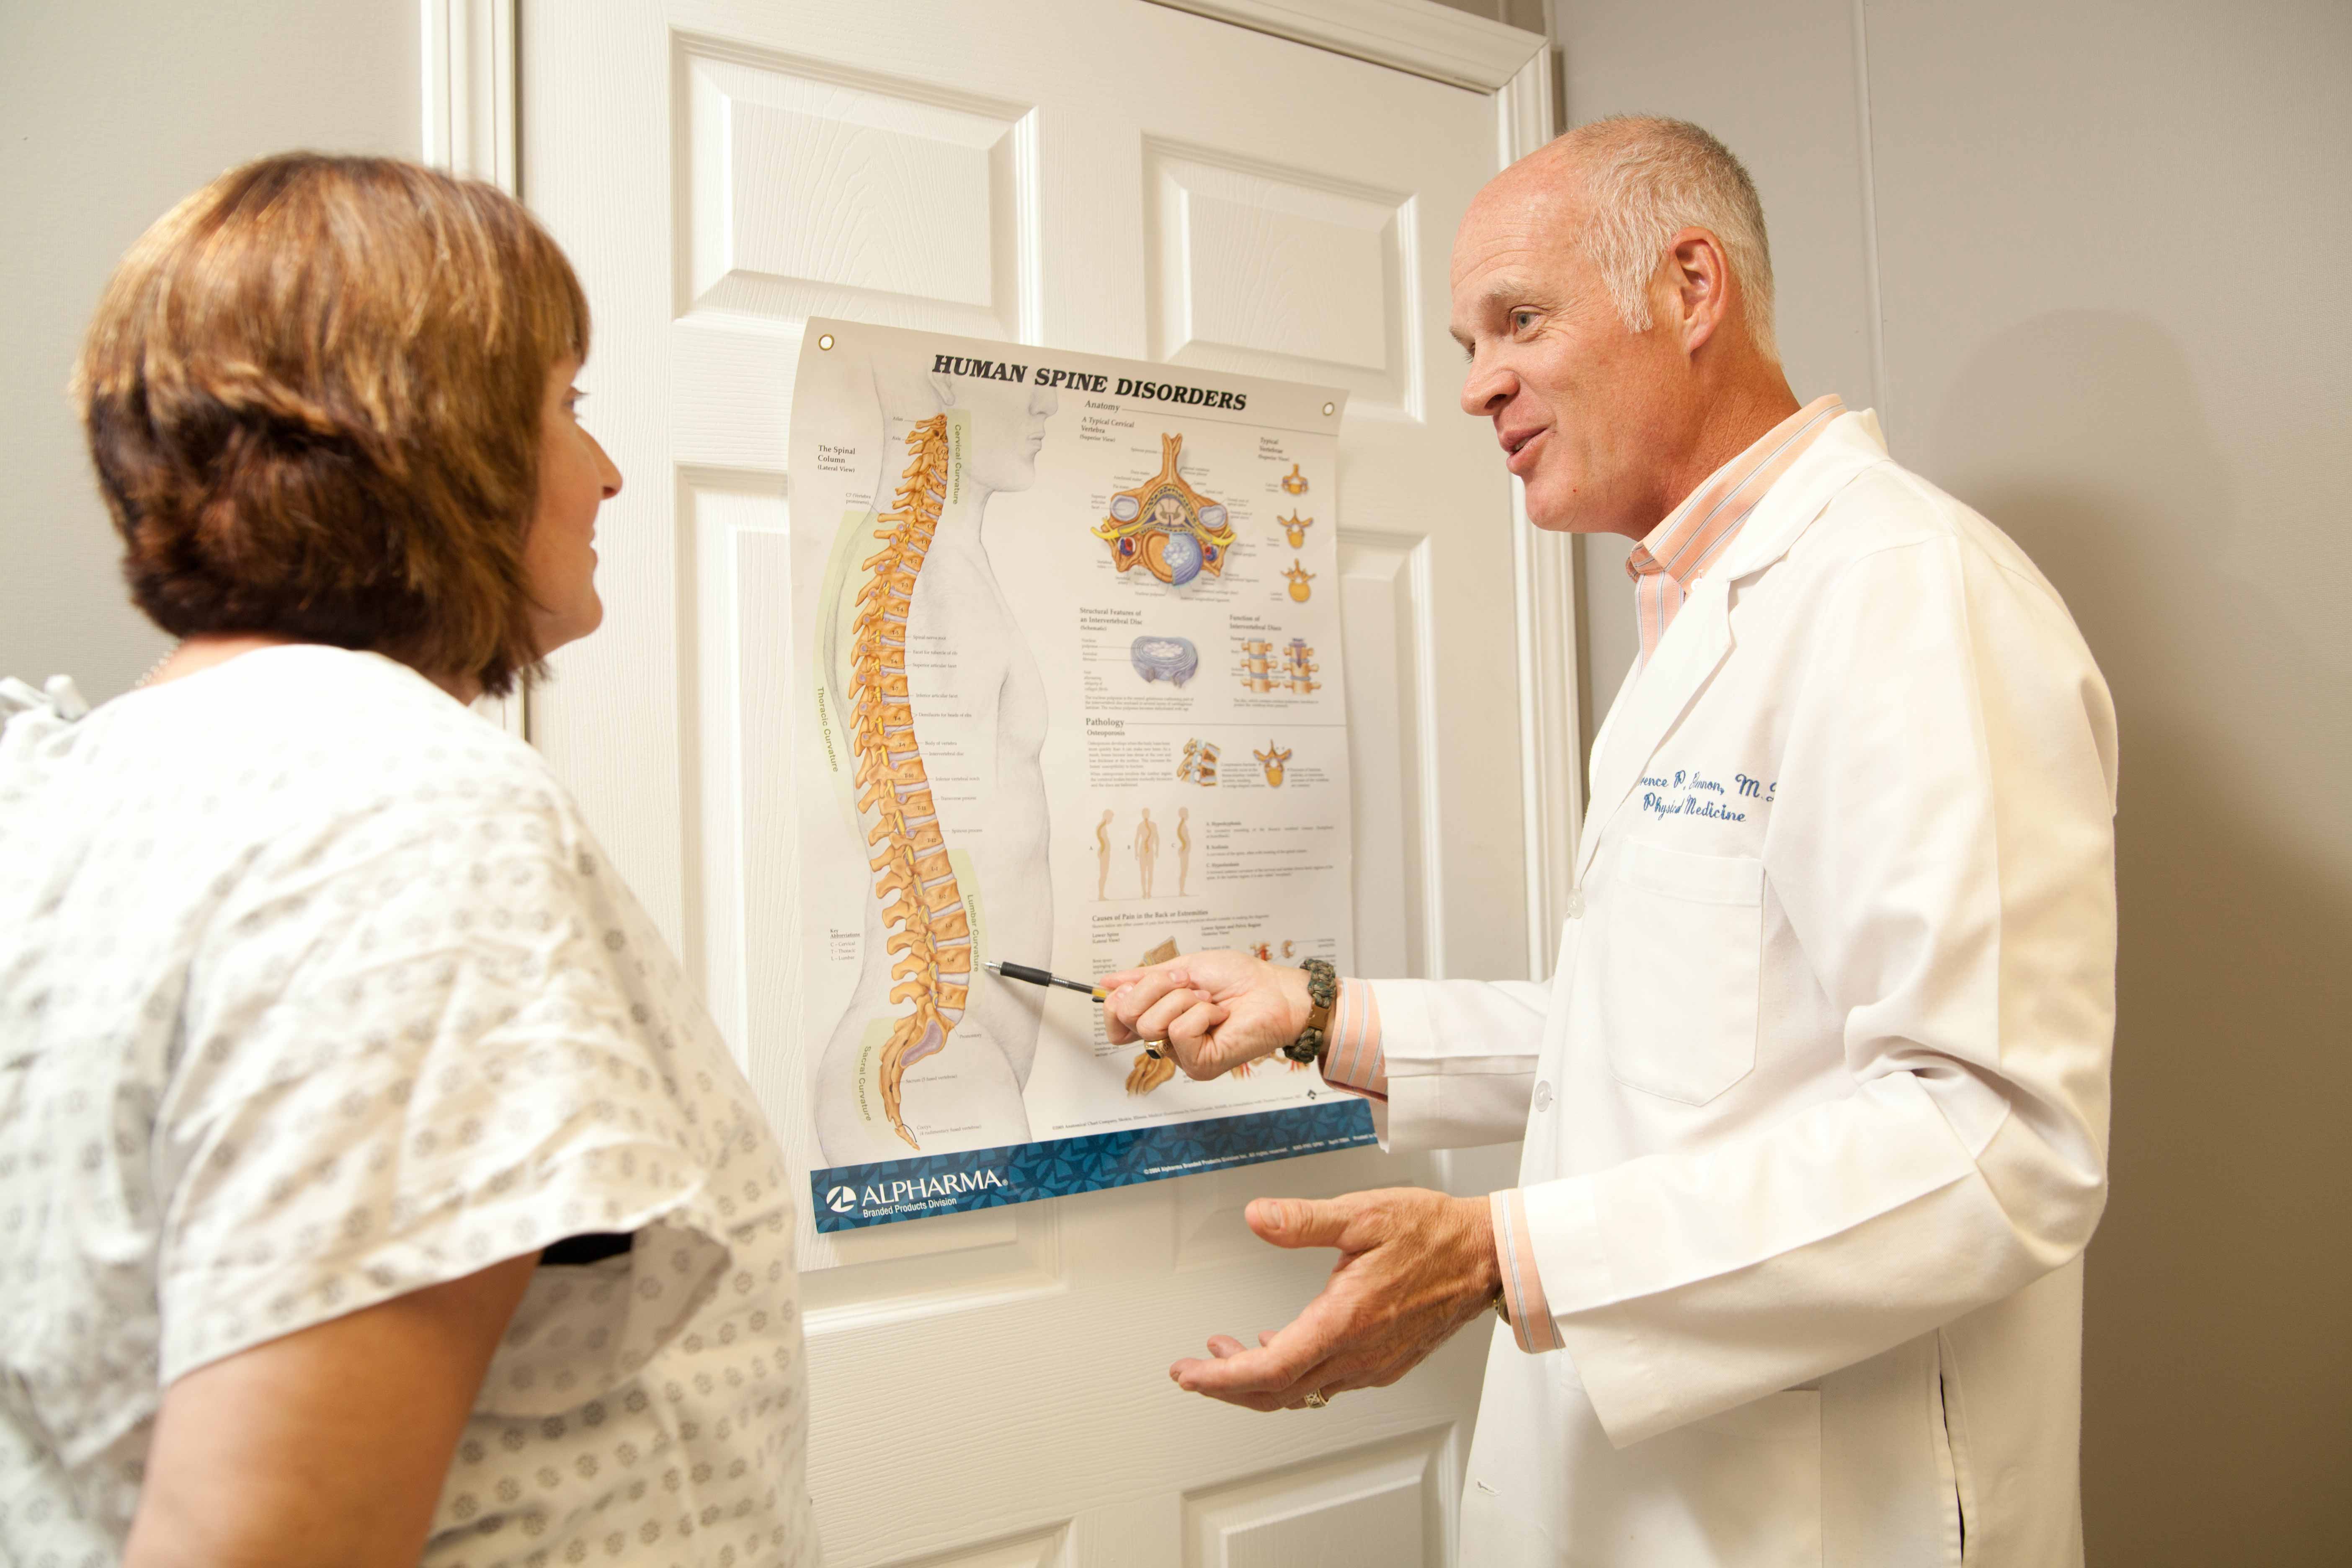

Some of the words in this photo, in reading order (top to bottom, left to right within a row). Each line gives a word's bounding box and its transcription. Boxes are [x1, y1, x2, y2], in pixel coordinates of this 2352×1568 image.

[932, 355, 1028, 383] HUMAN
[1034, 368, 1108, 393] SPINE
[1115, 379, 1247, 411] DISORDERS
[1085, 400, 1120, 413] Anatomy
[1088, 417, 1109, 426] Typical
[818, 455, 845, 463] Column
[834, 446, 855, 454] Spinal
[953, 463, 962, 504] Curvature
[818, 687, 828, 726] Thoracic
[824, 728, 838, 772] Curvature
[1086, 717, 1125, 729] Pathology
[1684, 794, 1746, 822] Medicine
[968, 895, 977, 930] Lumbar
[859, 1046, 871, 1075] Sacral
[859, 1078, 871, 1121] Curvature
[863, 1207, 893, 1218] Branded
[895, 1202, 927, 1214] Products
[929, 1197, 957, 1208] Division
